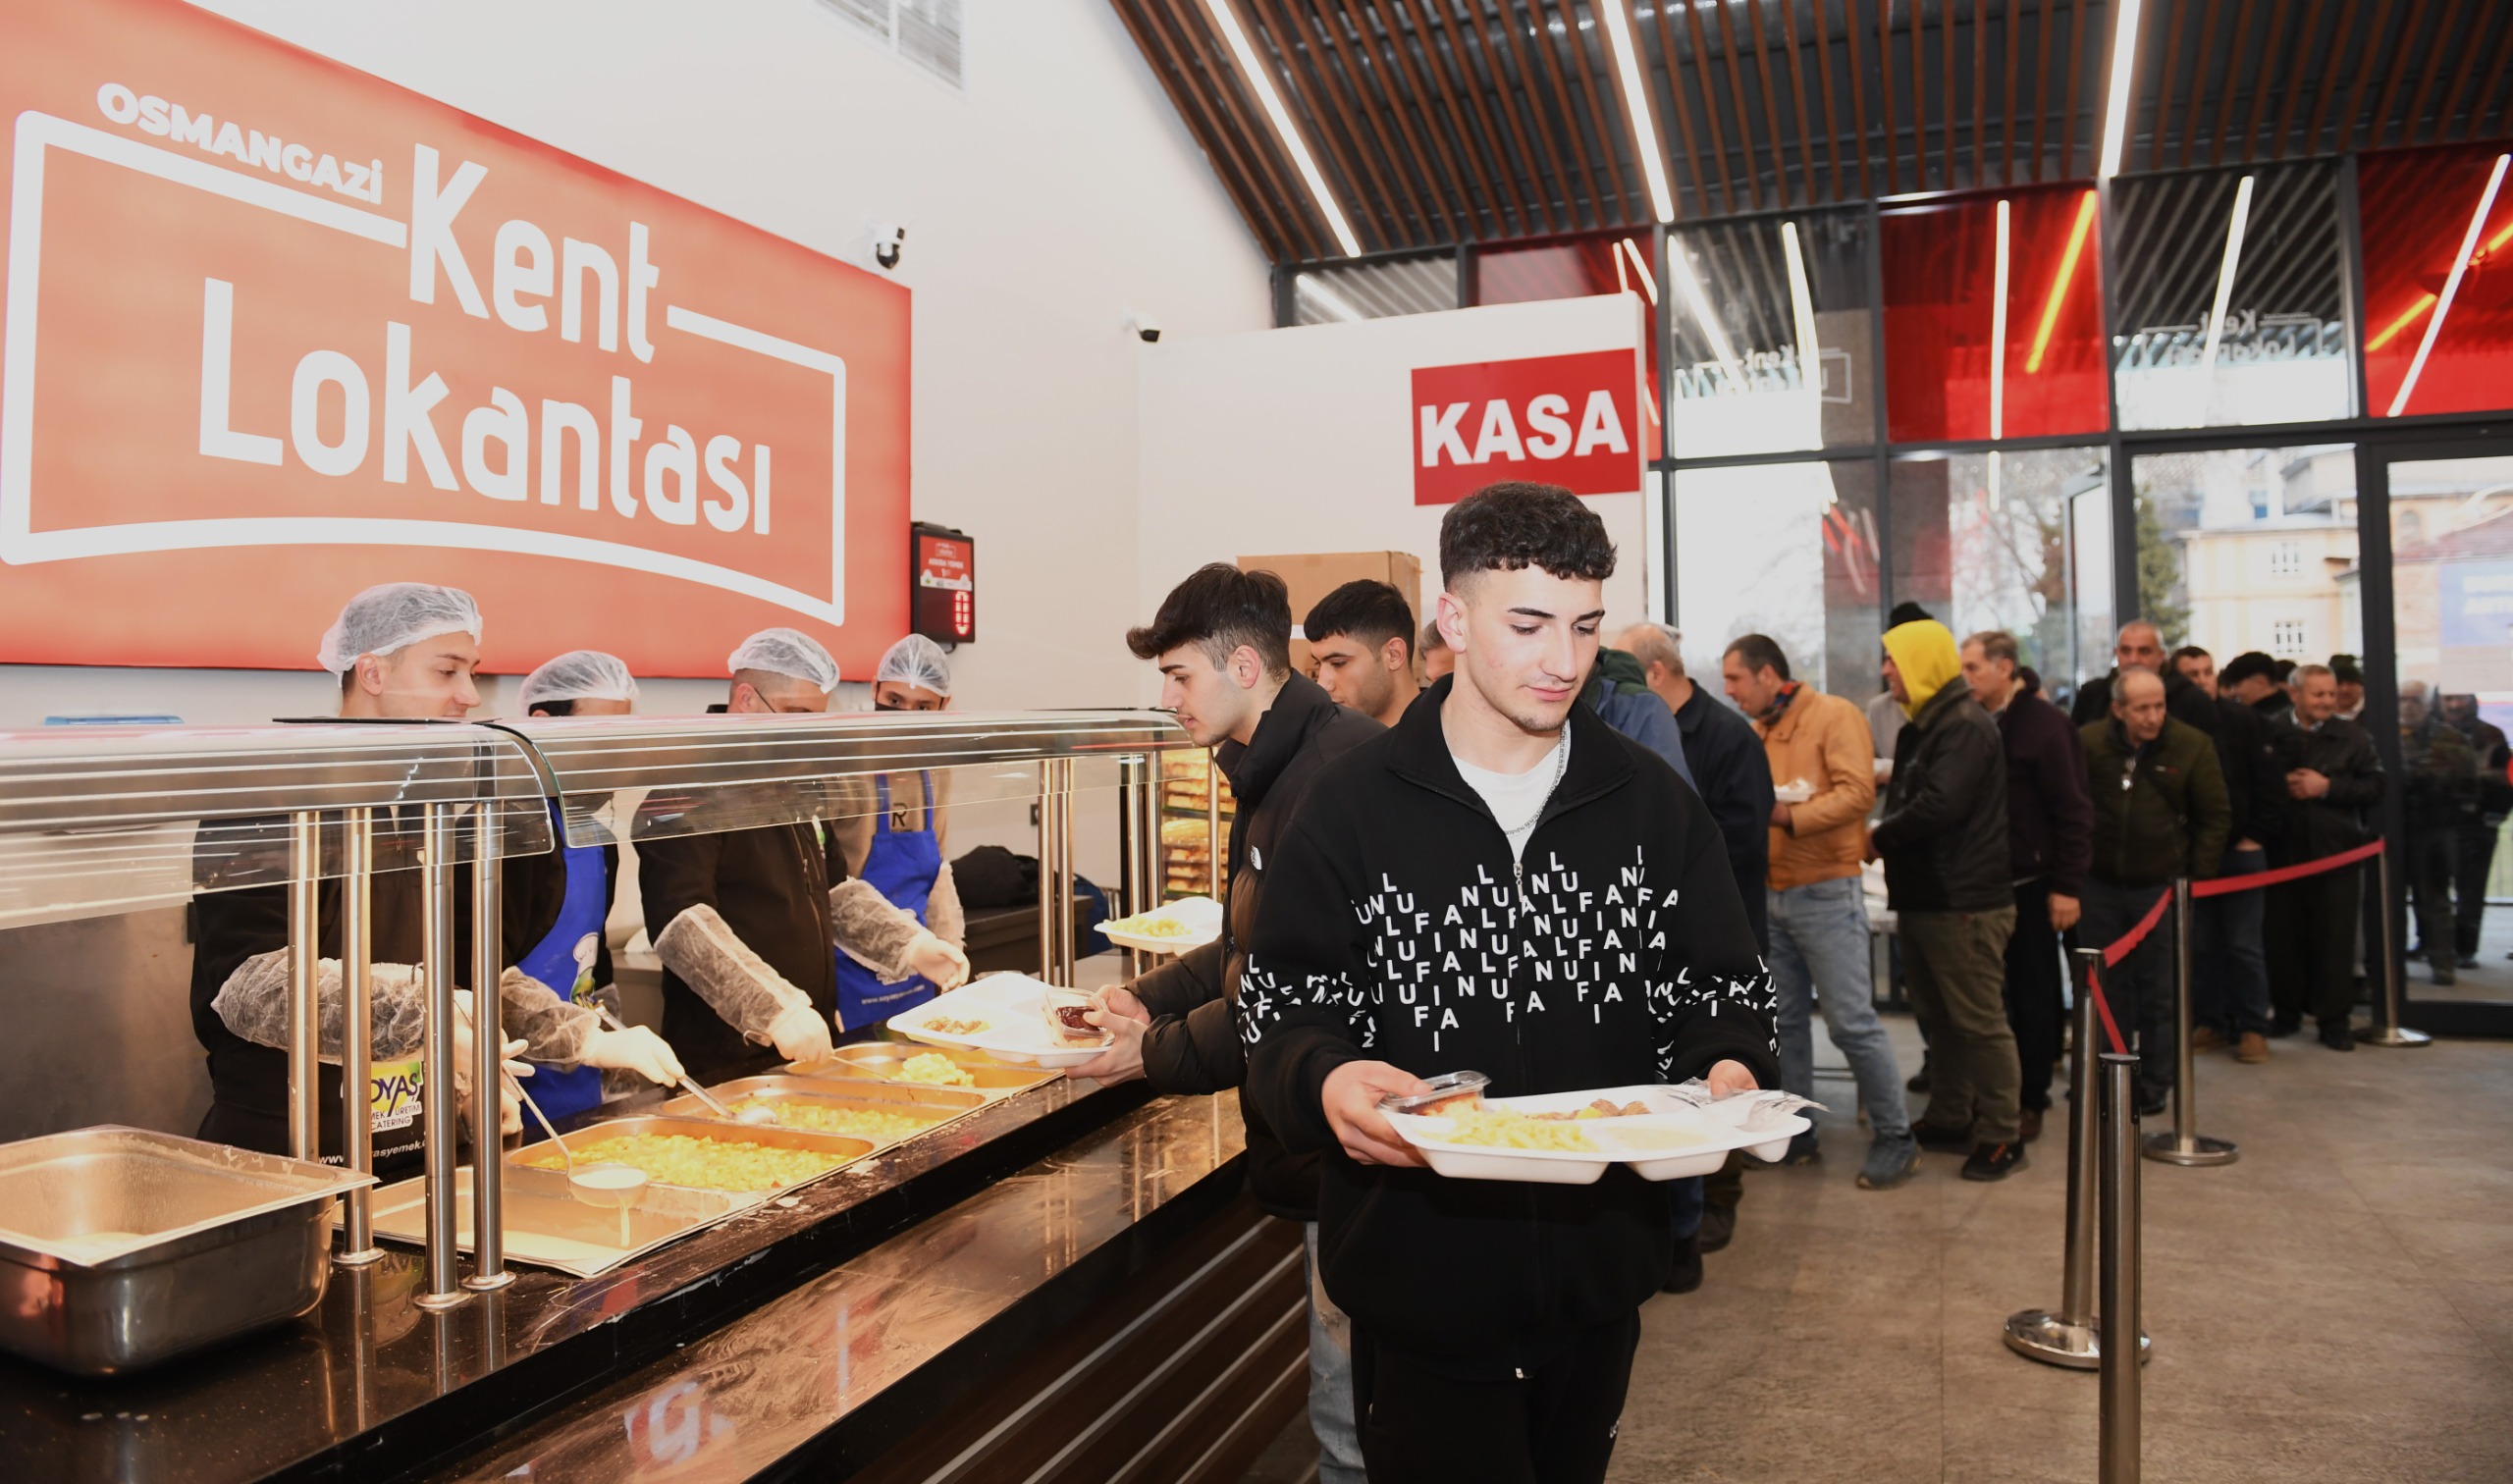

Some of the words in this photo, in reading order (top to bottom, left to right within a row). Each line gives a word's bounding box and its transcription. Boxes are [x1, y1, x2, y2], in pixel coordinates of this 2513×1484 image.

[409, 143, 660, 363] Kent
[199, 277, 772, 536] Lokantası
[1420, 390, 1629, 468] KASA
[371, 1117, 411, 1131] CATERING
